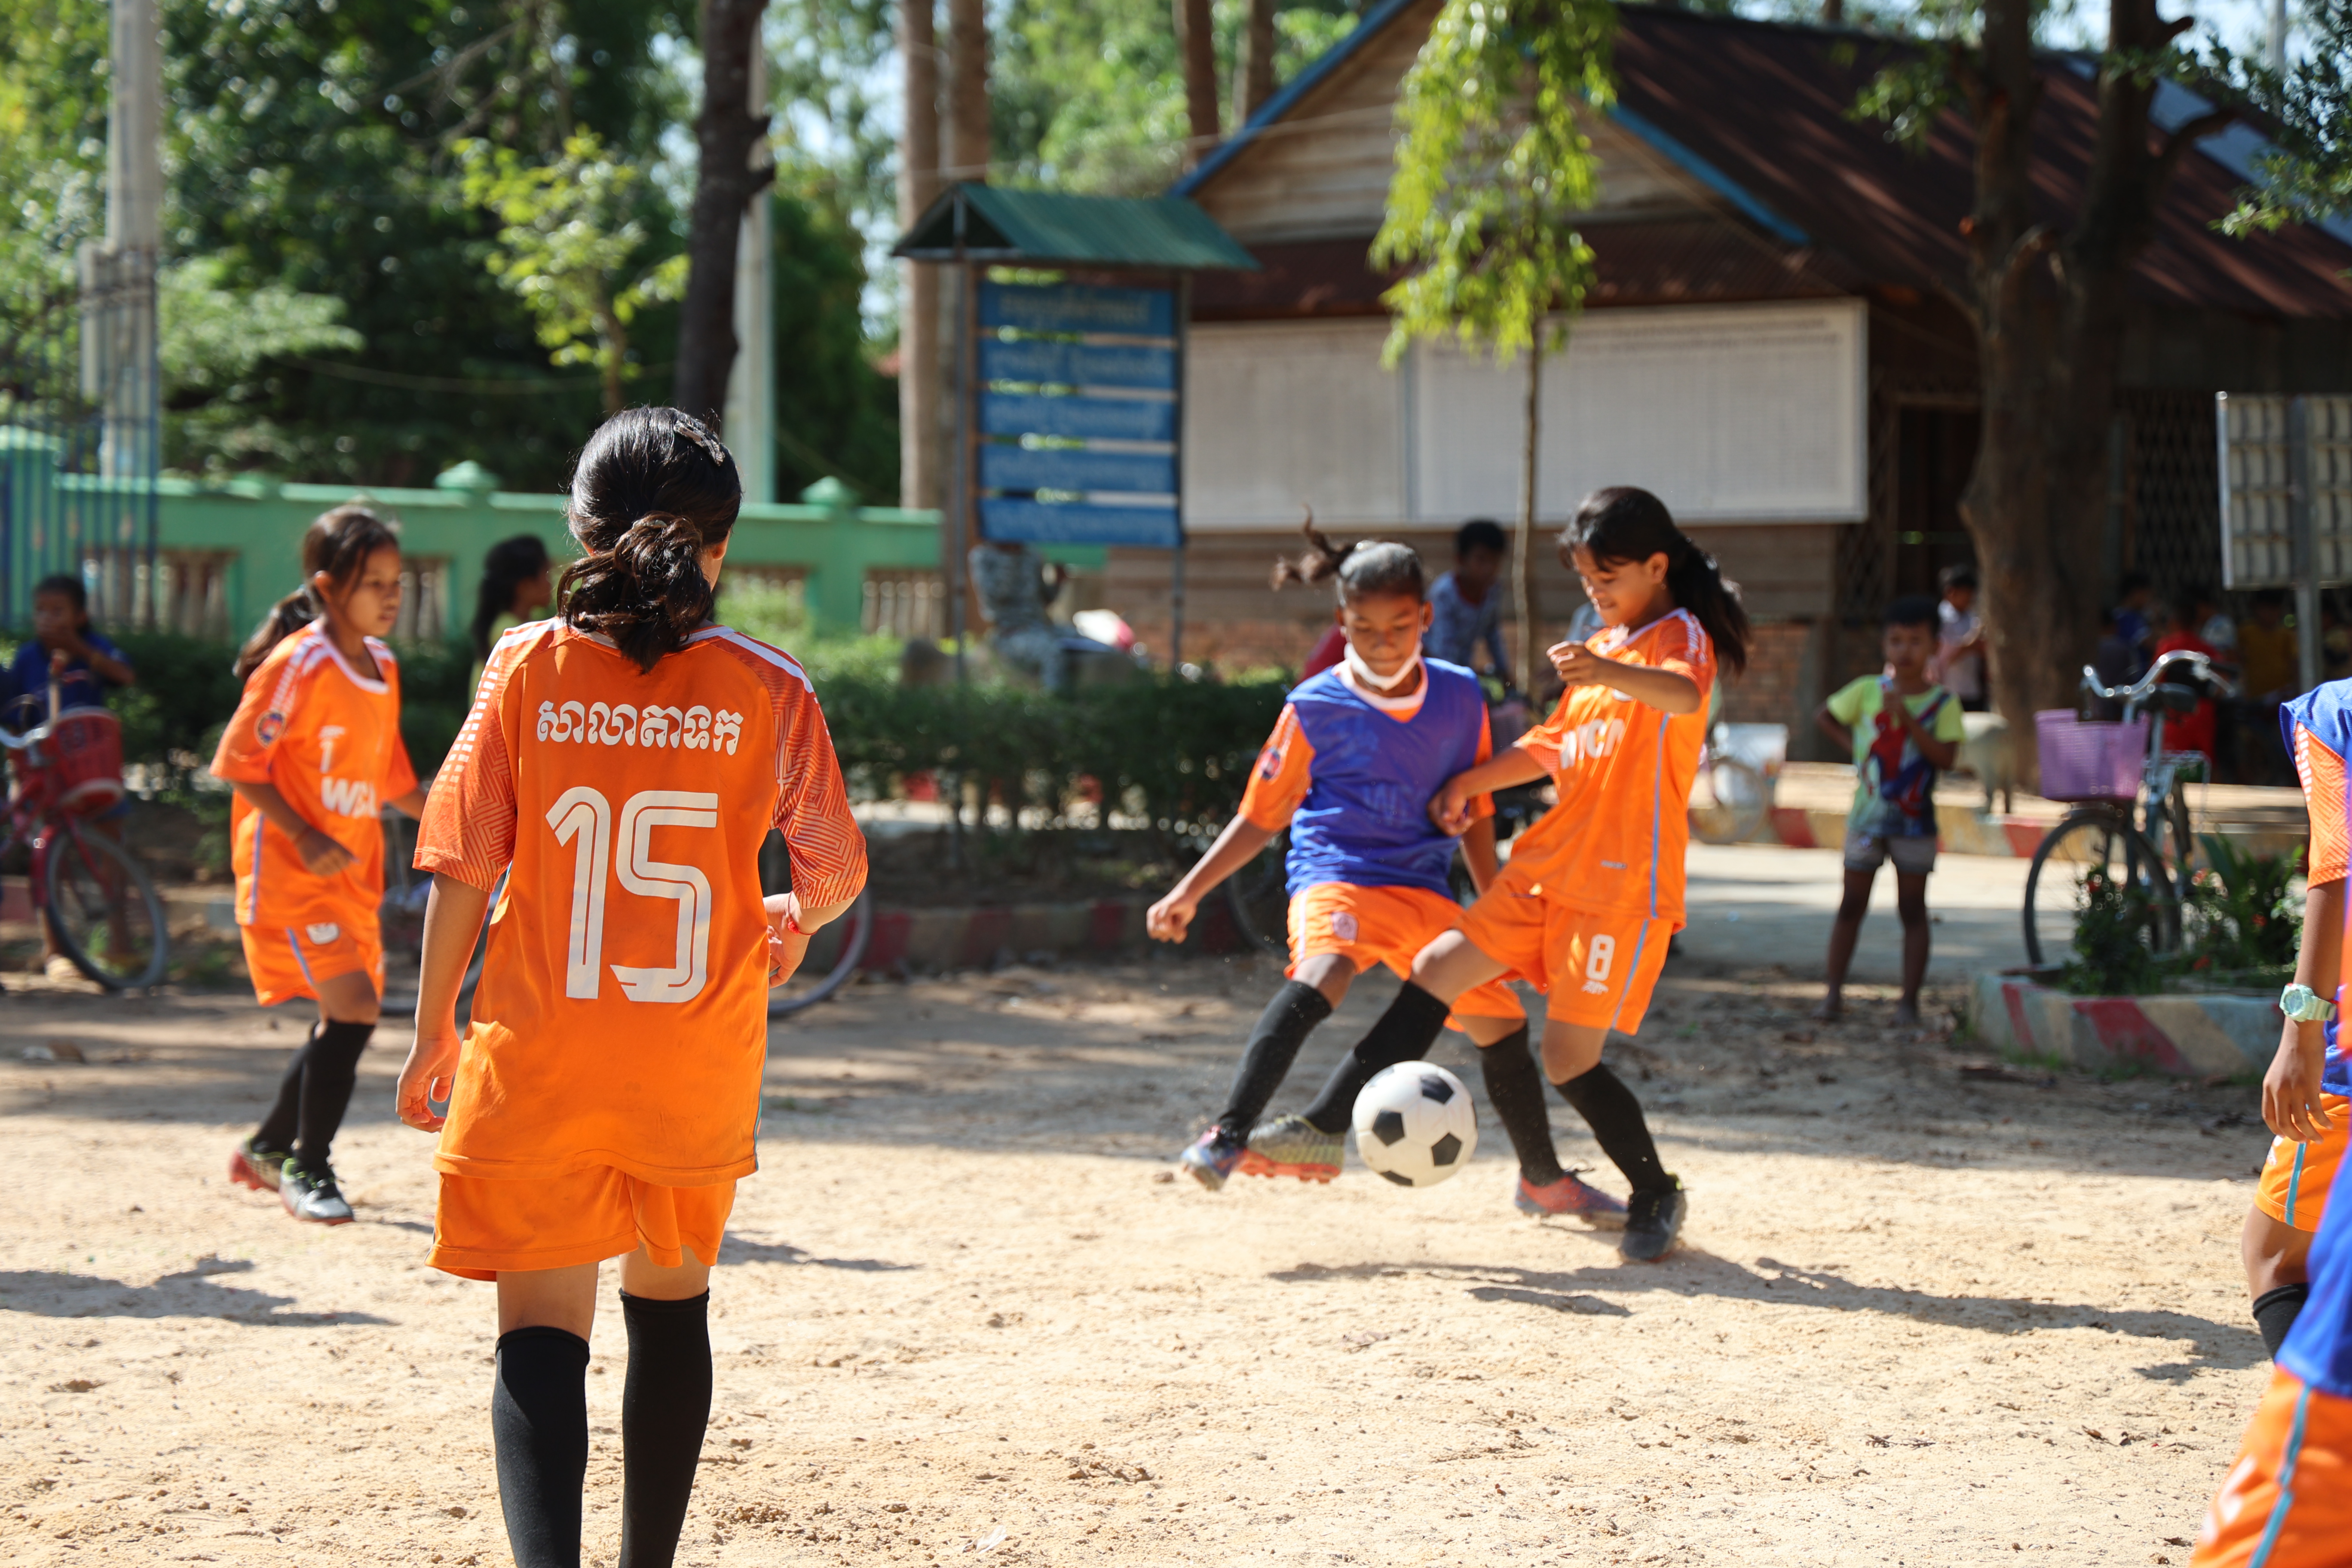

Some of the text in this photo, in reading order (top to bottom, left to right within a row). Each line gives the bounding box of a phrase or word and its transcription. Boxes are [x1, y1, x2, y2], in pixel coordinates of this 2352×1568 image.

[537, 700, 744, 756] សាលាតាទក
[545, 786, 718, 1003] 15
[1586, 934, 1616, 981] 8
